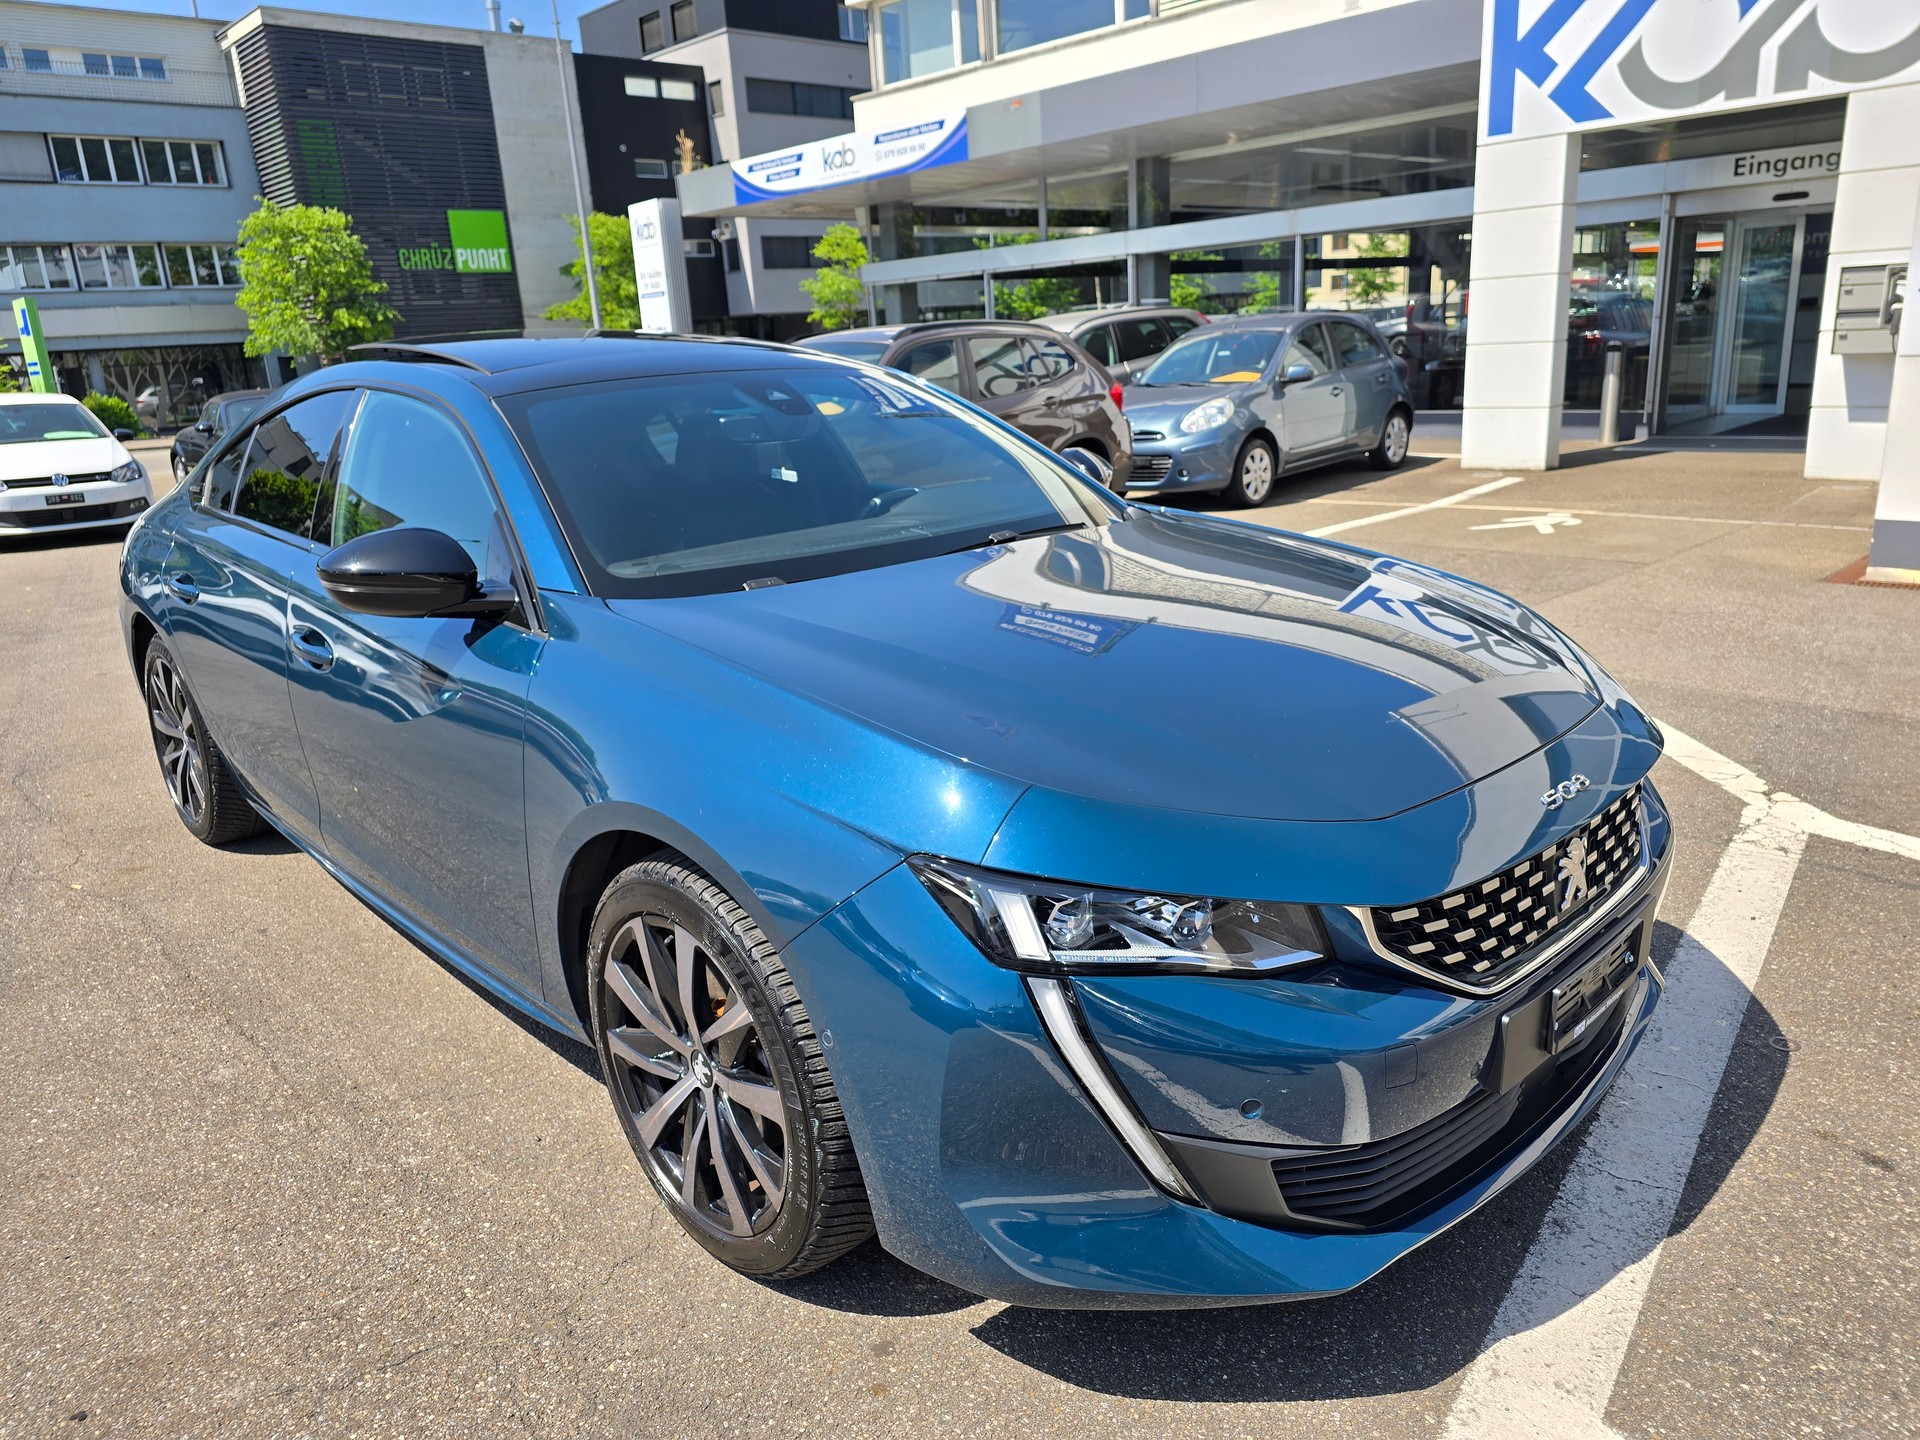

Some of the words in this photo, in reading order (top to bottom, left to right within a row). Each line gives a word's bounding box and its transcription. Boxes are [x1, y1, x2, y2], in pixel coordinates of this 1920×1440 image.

[821, 142, 856, 173] kab
[1734, 151, 1841, 177] Eingang
[398, 241, 455, 271] CHRÜZ
[455, 247, 508, 271] PUNKT
[1540, 773, 1590, 810] 508
[725, 951, 803, 1112] MICHELIN
